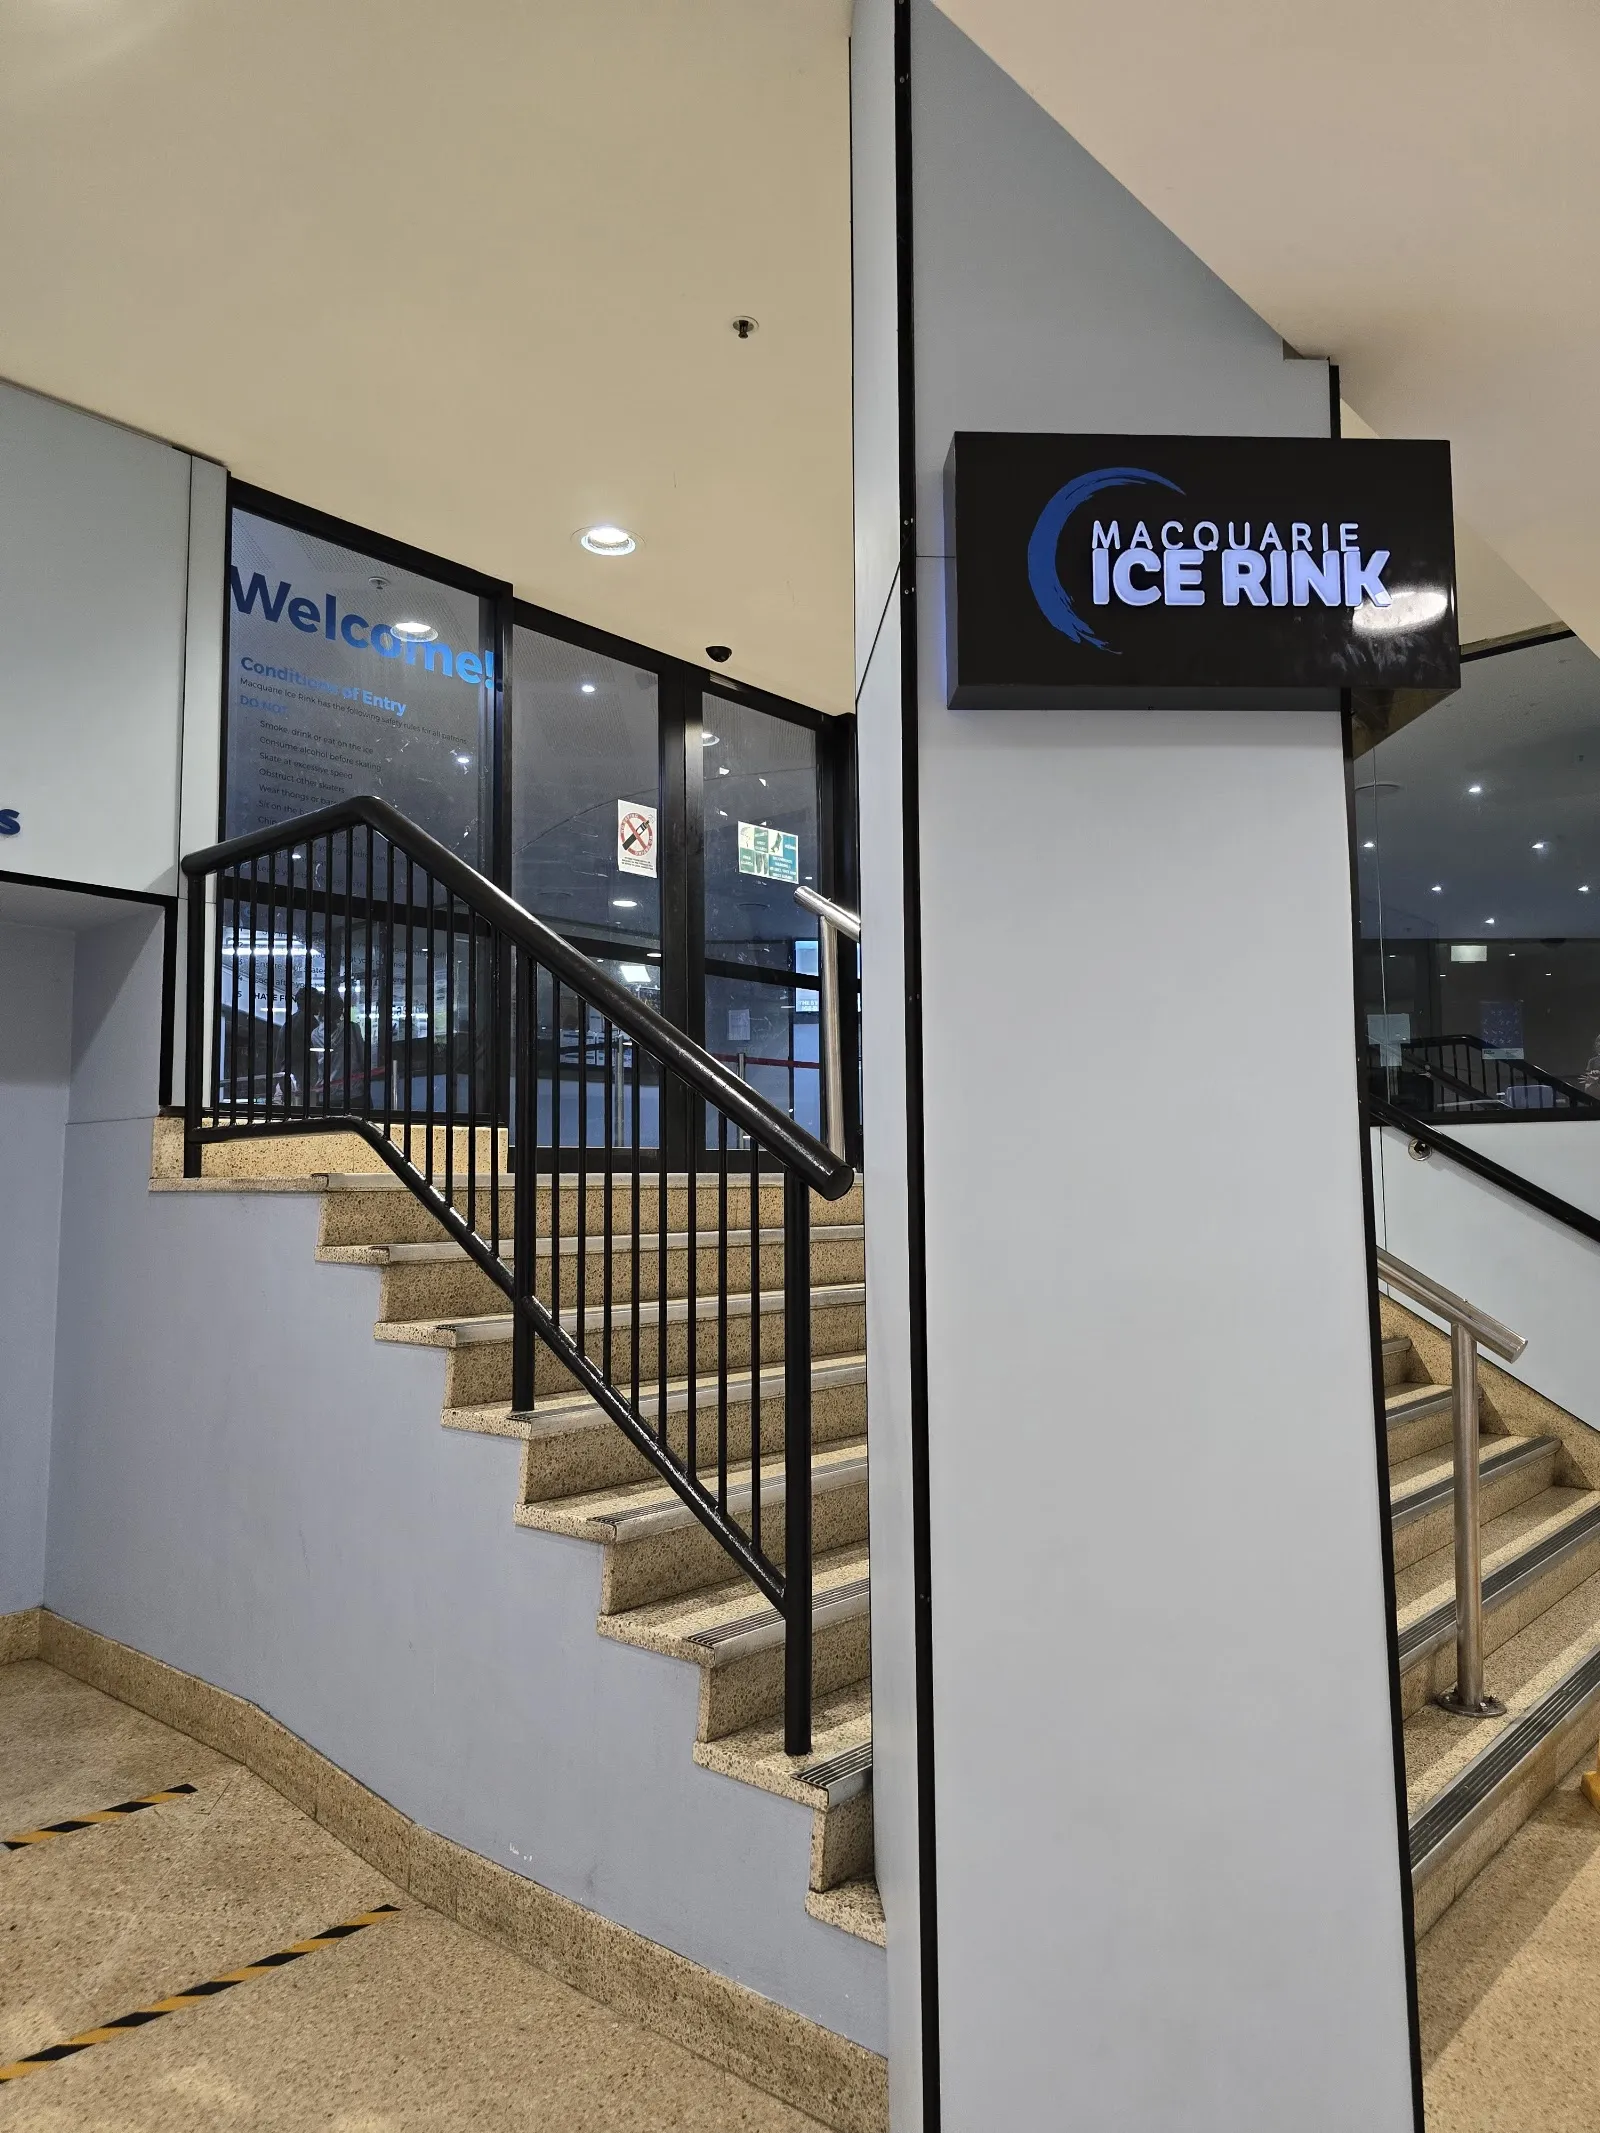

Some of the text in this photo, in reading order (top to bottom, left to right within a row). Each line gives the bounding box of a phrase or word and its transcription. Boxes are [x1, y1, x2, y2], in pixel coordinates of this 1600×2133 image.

[1091, 520, 1360, 551] MACQUARIE
[1092, 548, 1392, 607] ICE RINK
[231, 565, 494, 689] Welcome!
[240, 695, 259, 708] DO
[241, 657, 408, 717] Conditions of Entry
[241, 677, 283, 695] Macquarie
[285, 689, 297, 699] Ice
[298, 693, 317, 705] Rink
[318, 698, 331, 709] has
[333, 702, 346, 712] the
[347, 705, 381, 723] following
[404, 721, 420, 732] rules
[259, 736, 383, 773] Consume alcohol before skating
[292, 728, 312, 740] drink
[313, 734, 322, 742] or
[324, 736, 336, 746] eat
[337, 739, 348, 748] on
[349, 742, 361, 752] the
[363, 745, 374, 755] ice
[259, 752, 282, 763] Skate
[293, 761, 329, 775] excessive
[330, 768, 353, 780] speed
[259, 768, 346, 794] Obstruct other skaters
[259, 783, 280, 794] Wear
[281, 788, 309, 802] thongs
[255, 992, 278, 1001] HAE
